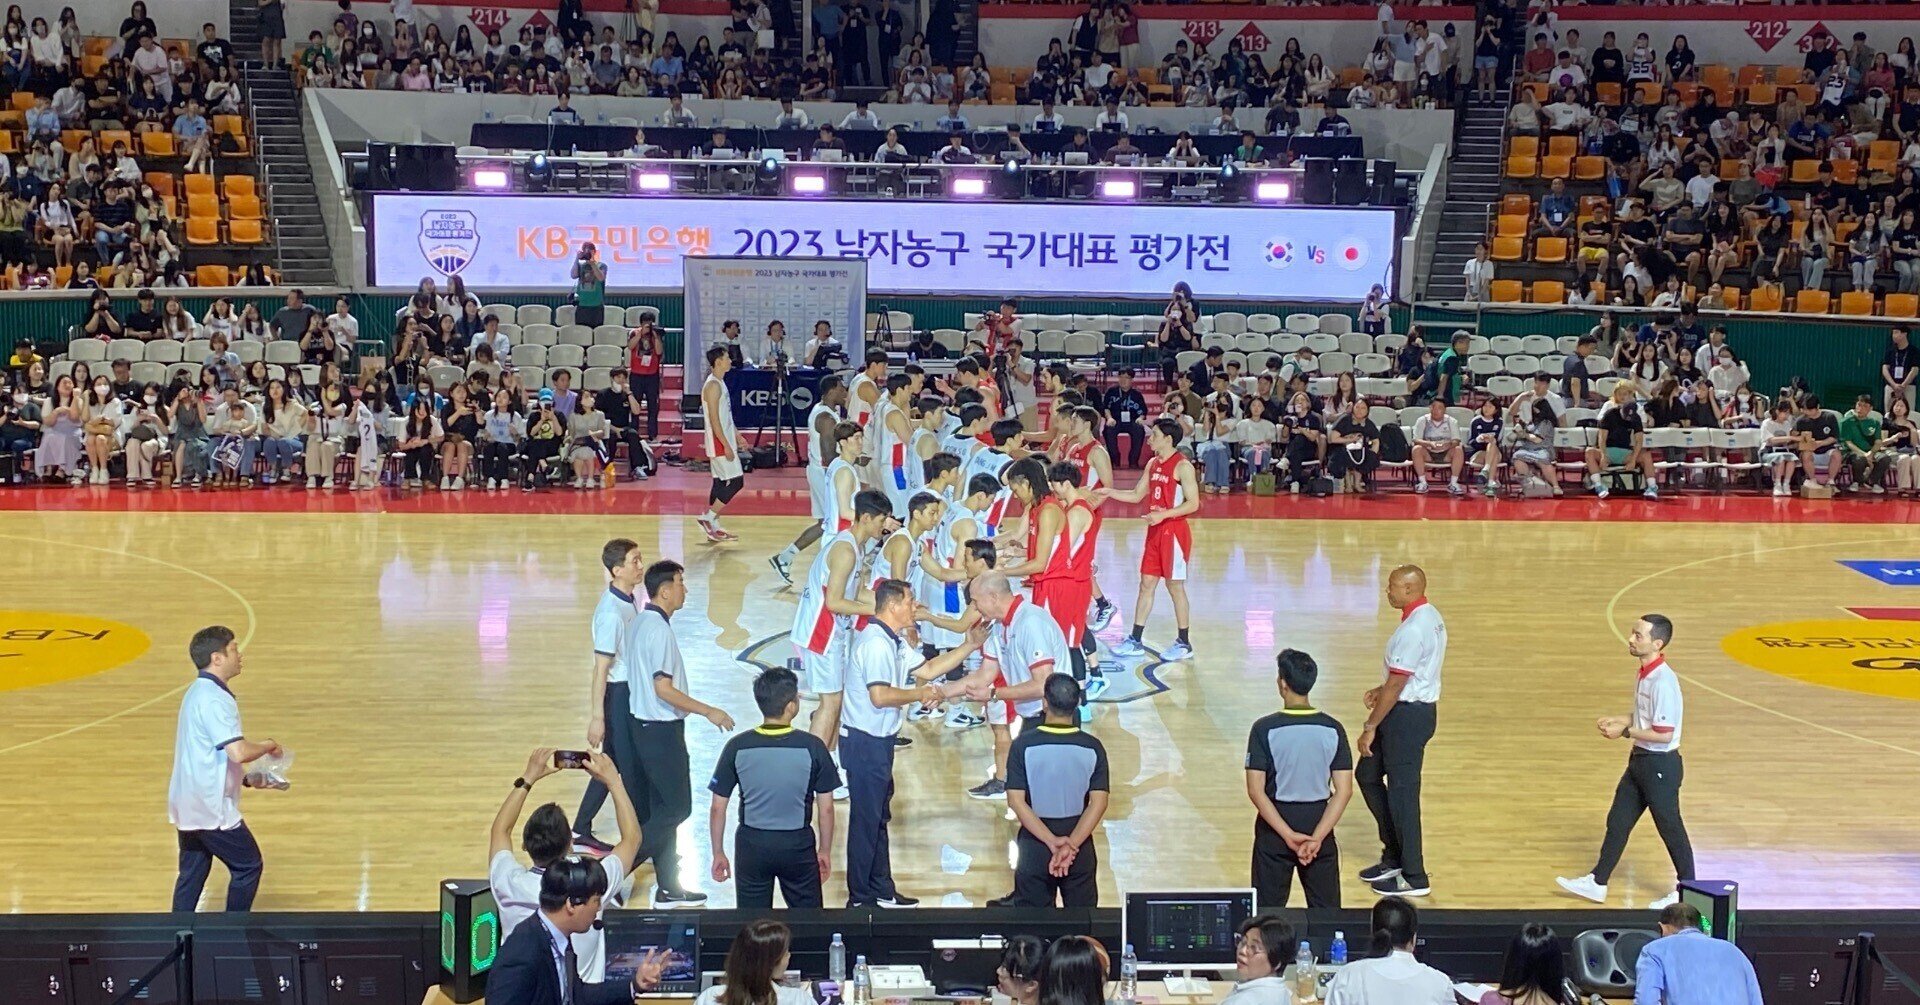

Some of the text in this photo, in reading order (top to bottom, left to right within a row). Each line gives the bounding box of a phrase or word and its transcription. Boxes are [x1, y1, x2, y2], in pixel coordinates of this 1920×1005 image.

[474, 8, 504, 26] 214
[1188, 20, 1218, 38] 213
[1752, 20, 1784, 39] 212
[1802, 35, 1834, 53] 32
[1633, 61, 1650, 74] 55
[734, 229, 824, 257] 2023
[836, 229, 970, 268] 남자농구
[983, 231, 1119, 269] 국가대표
[1129, 233, 1230, 272] 평가전
[755, 269, 772, 277] 2023
[774, 268, 800, 278] 남자농구
[802, 270, 828, 278] 국가대표
[1154, 486, 1162, 500] 8
[471, 911, 497, 970] 0
